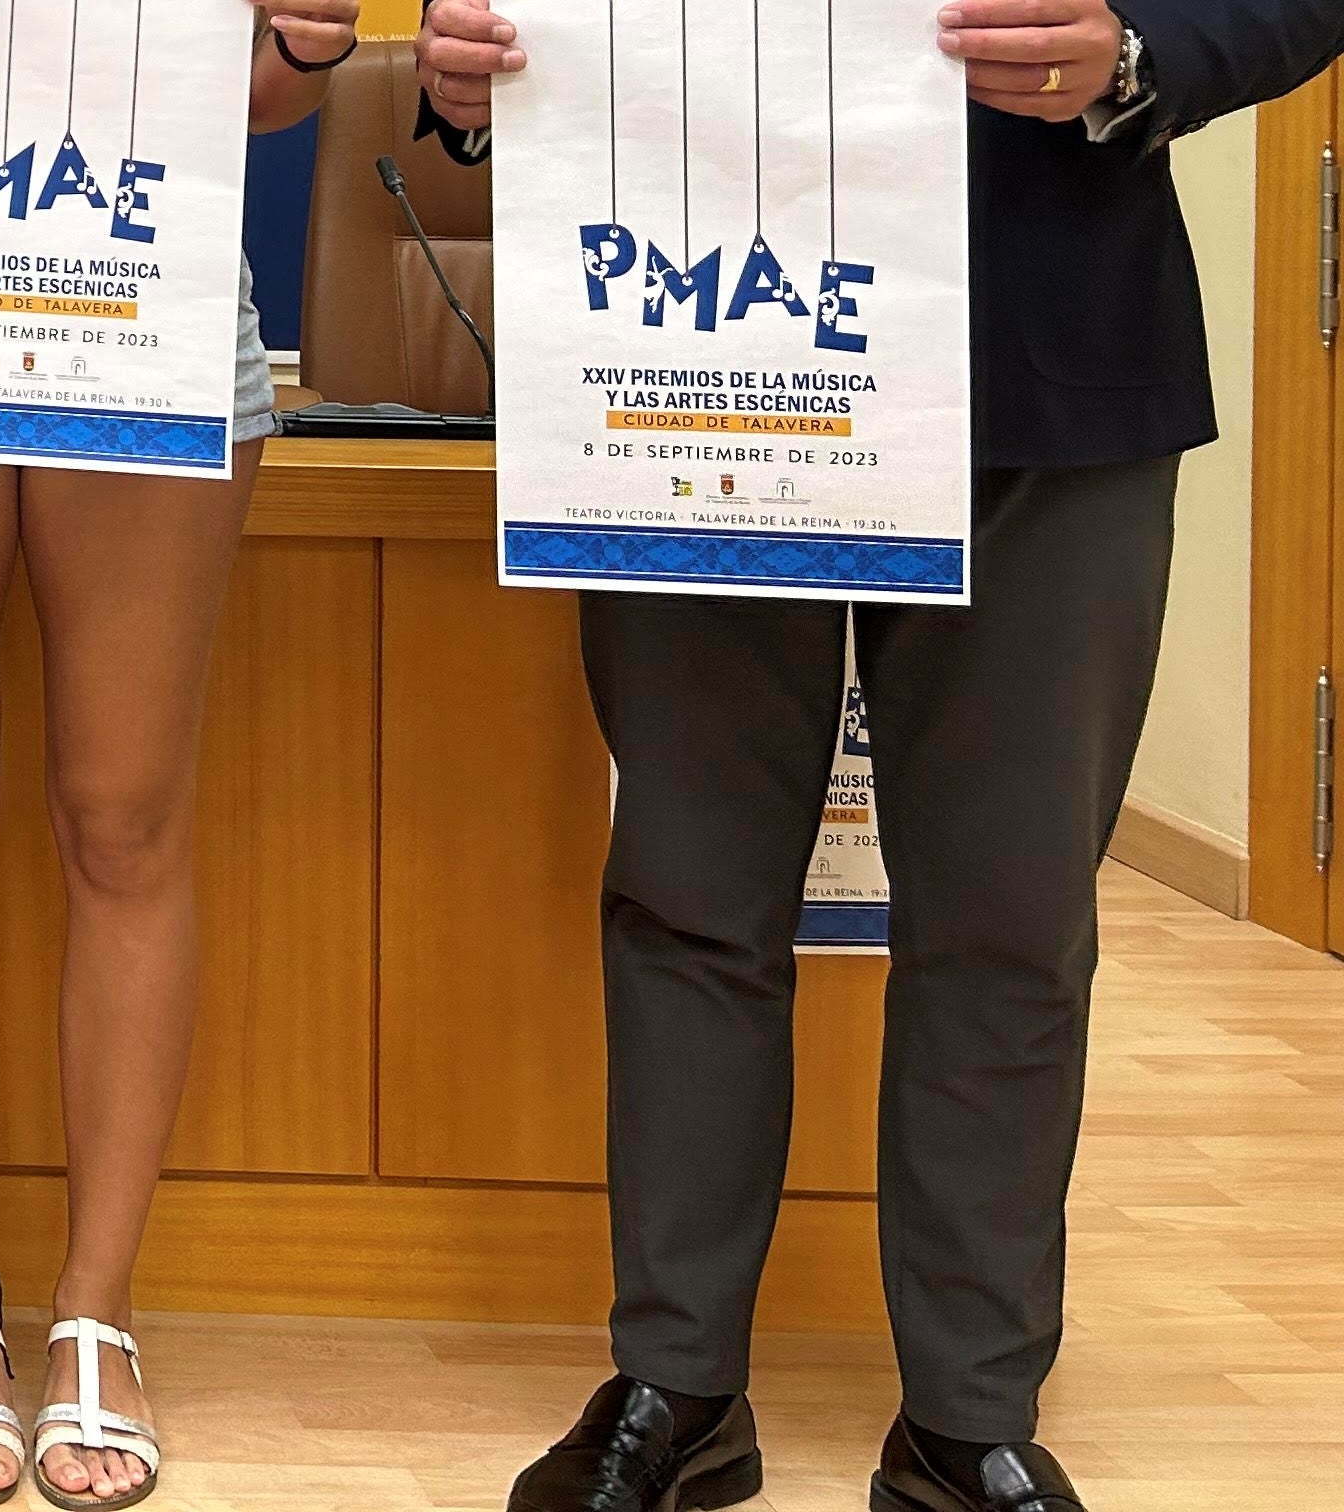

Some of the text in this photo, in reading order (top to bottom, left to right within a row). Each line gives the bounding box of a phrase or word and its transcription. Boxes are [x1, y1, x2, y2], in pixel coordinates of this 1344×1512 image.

[36, 257, 59, 272] DE
[64, 259, 84, 275] LA
[90, 257, 161, 279] MÚSICA
[39, 275, 138, 298] ESCÉNICAS
[579, 224, 874, 353] PMAE
[14, 297, 33, 309] DE
[44, 300, 123, 314] TALAVERA
[83, 330, 105, 343] DE
[118, 333, 159, 347] 2023
[582, 368, 877, 392] XXIV PREMIOS DE LA MÚSICA
[56, 391, 70, 401] DE
[74, 392, 87, 402] LA
[91, 393, 125, 405] REINA
[607, 390, 851, 413] Y LAS ARTES ESCÉNICAS
[624, 414, 834, 431] CIUDAD DE TALAVERA
[584, 443, 878, 466] 8 DE SEPTIEMBRE DE 2023
[565, 507, 612, 519] TEATRO
[616, 510, 676, 521] VICTORIA
[691, 513, 754, 525] TALAVERA
[760, 516, 776, 526] DE
[781, 517, 796, 526] LA
[802, 518, 841, 528] REINA
[829, 770, 874, 788] MÚSIC
[824, 792, 868, 805] NICAS
[825, 835, 878, 847] DE 202
[806, 888, 816, 896] DE
[821, 888, 831, 896] LA
[835, 888, 863, 896] REINA
